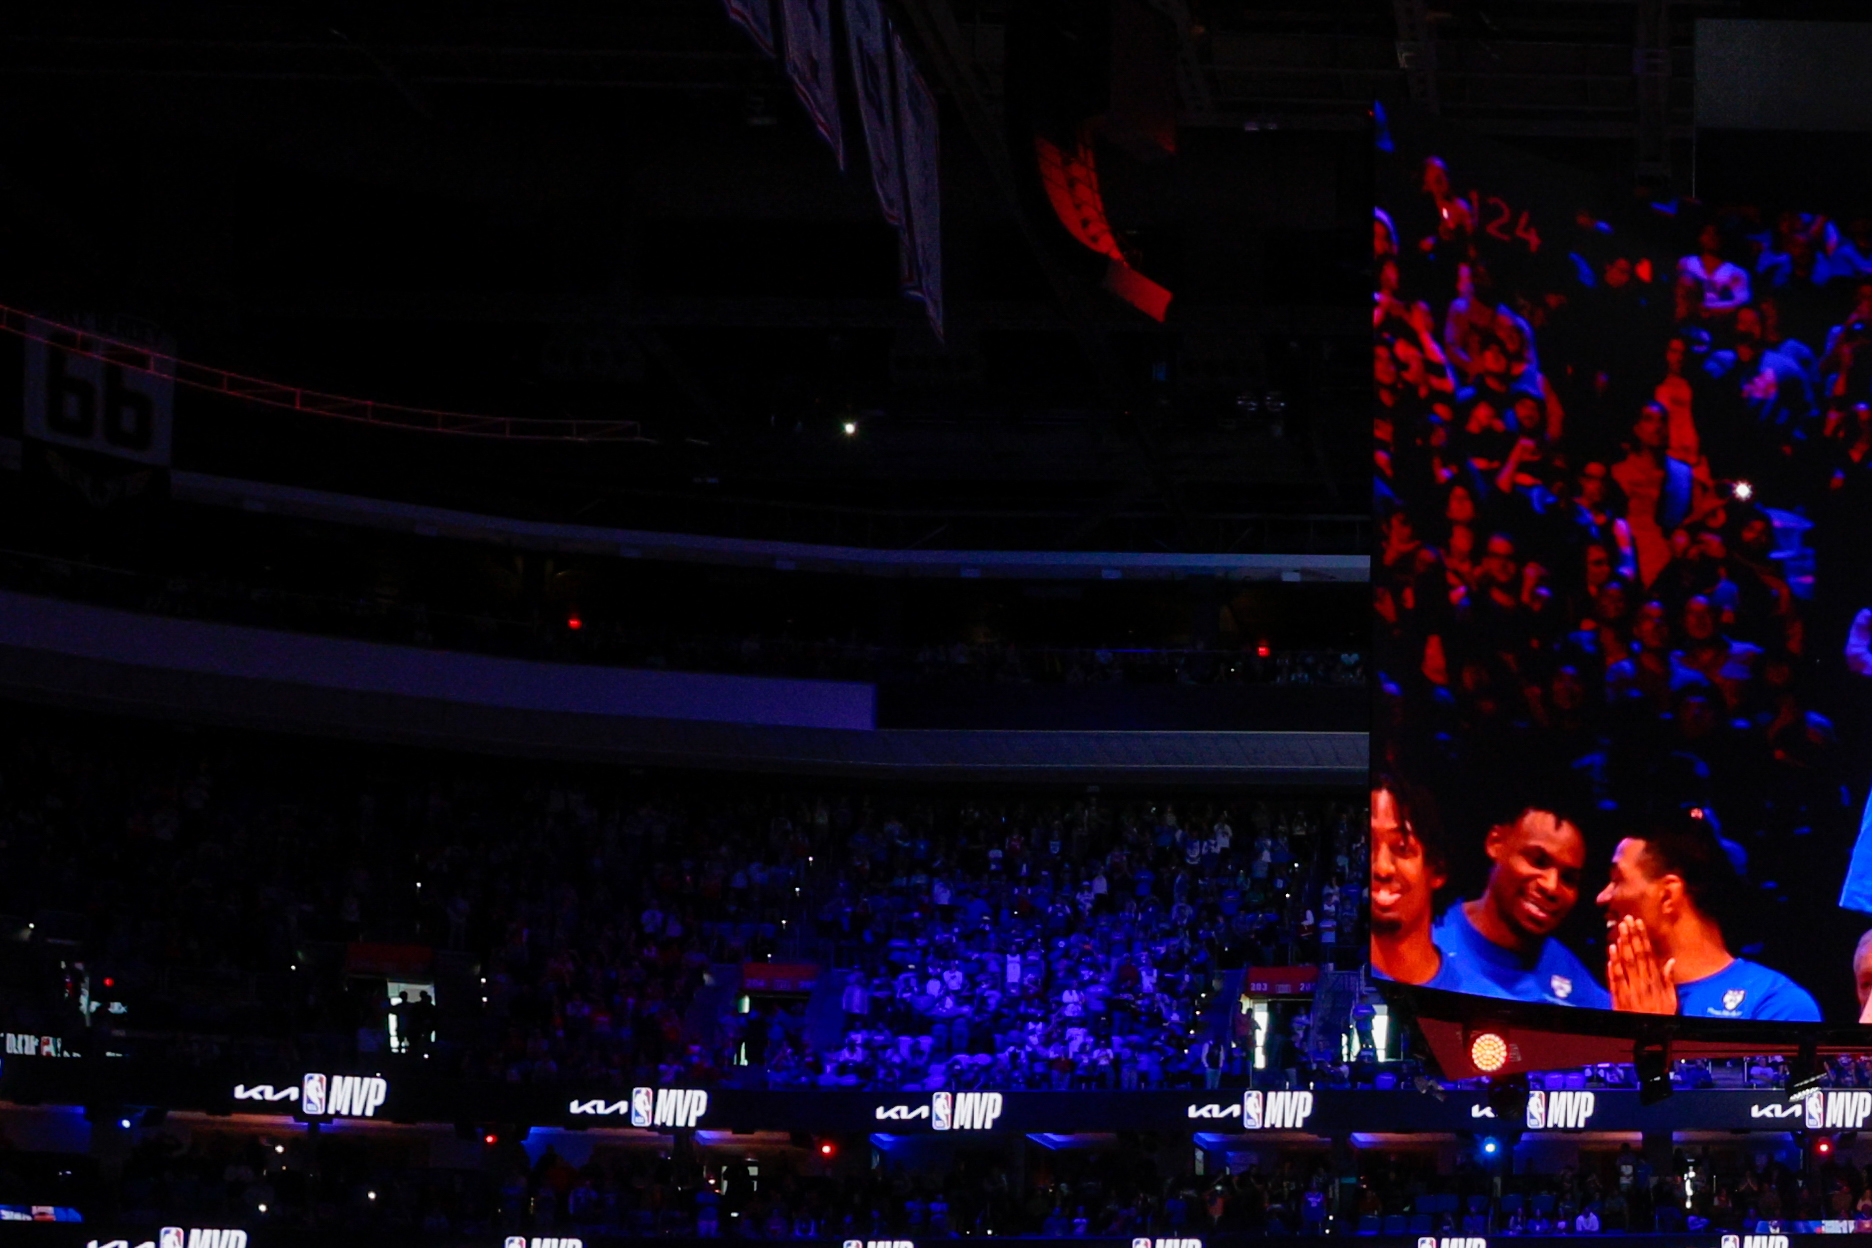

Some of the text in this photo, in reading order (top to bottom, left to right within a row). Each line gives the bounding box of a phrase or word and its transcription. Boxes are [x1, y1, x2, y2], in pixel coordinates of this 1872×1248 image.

[328, 1075, 386, 1117] MVP
[654, 1089, 707, 1127] MVP
[953, 1092, 1002, 1129] MVP
[1264, 1091, 1313, 1128] MVP
[1547, 1091, 1594, 1128] MVP
[1826, 1092, 1872, 1128] MVP
